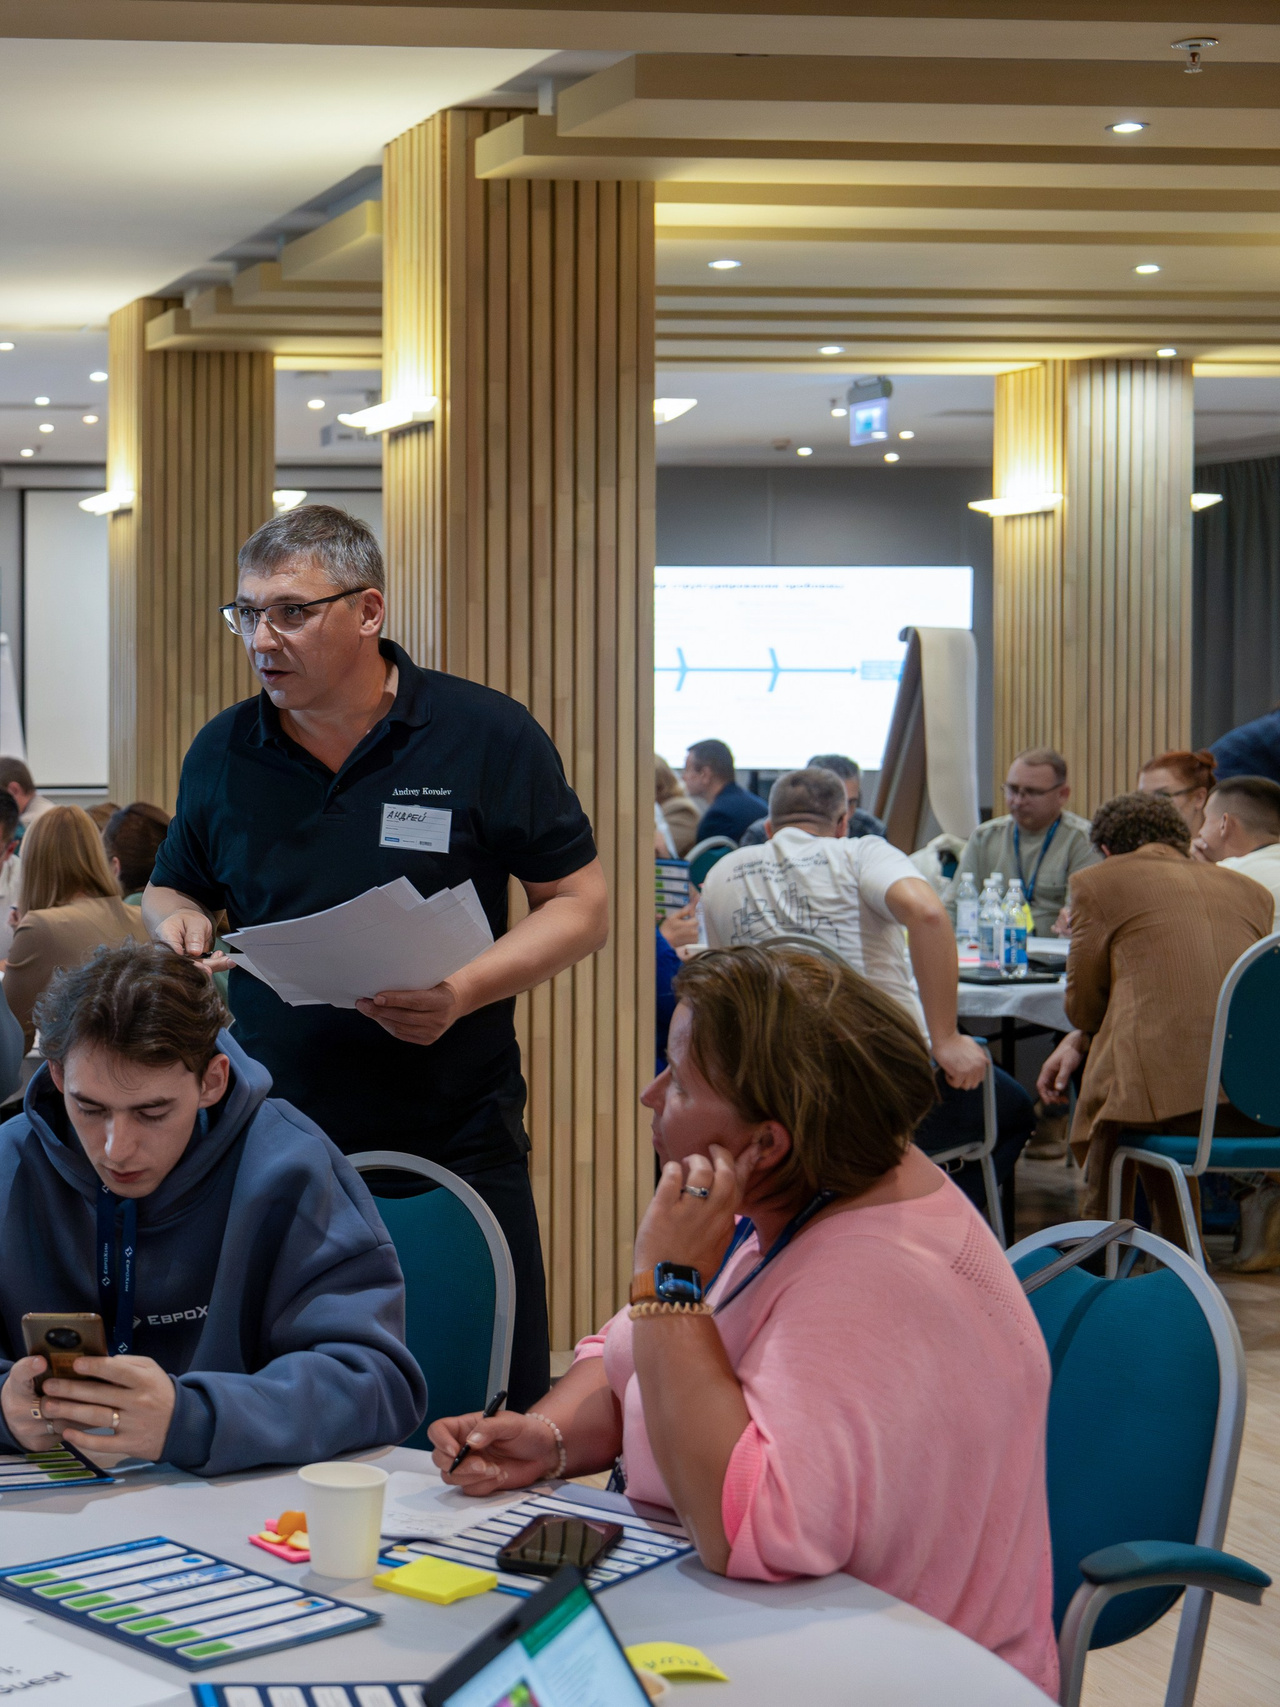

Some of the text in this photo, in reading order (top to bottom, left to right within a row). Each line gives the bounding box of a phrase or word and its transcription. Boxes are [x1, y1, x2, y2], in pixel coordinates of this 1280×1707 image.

[392, 787, 452, 797] Andrey Korolev
[386, 810, 428, 823] АНДРЕЙ
